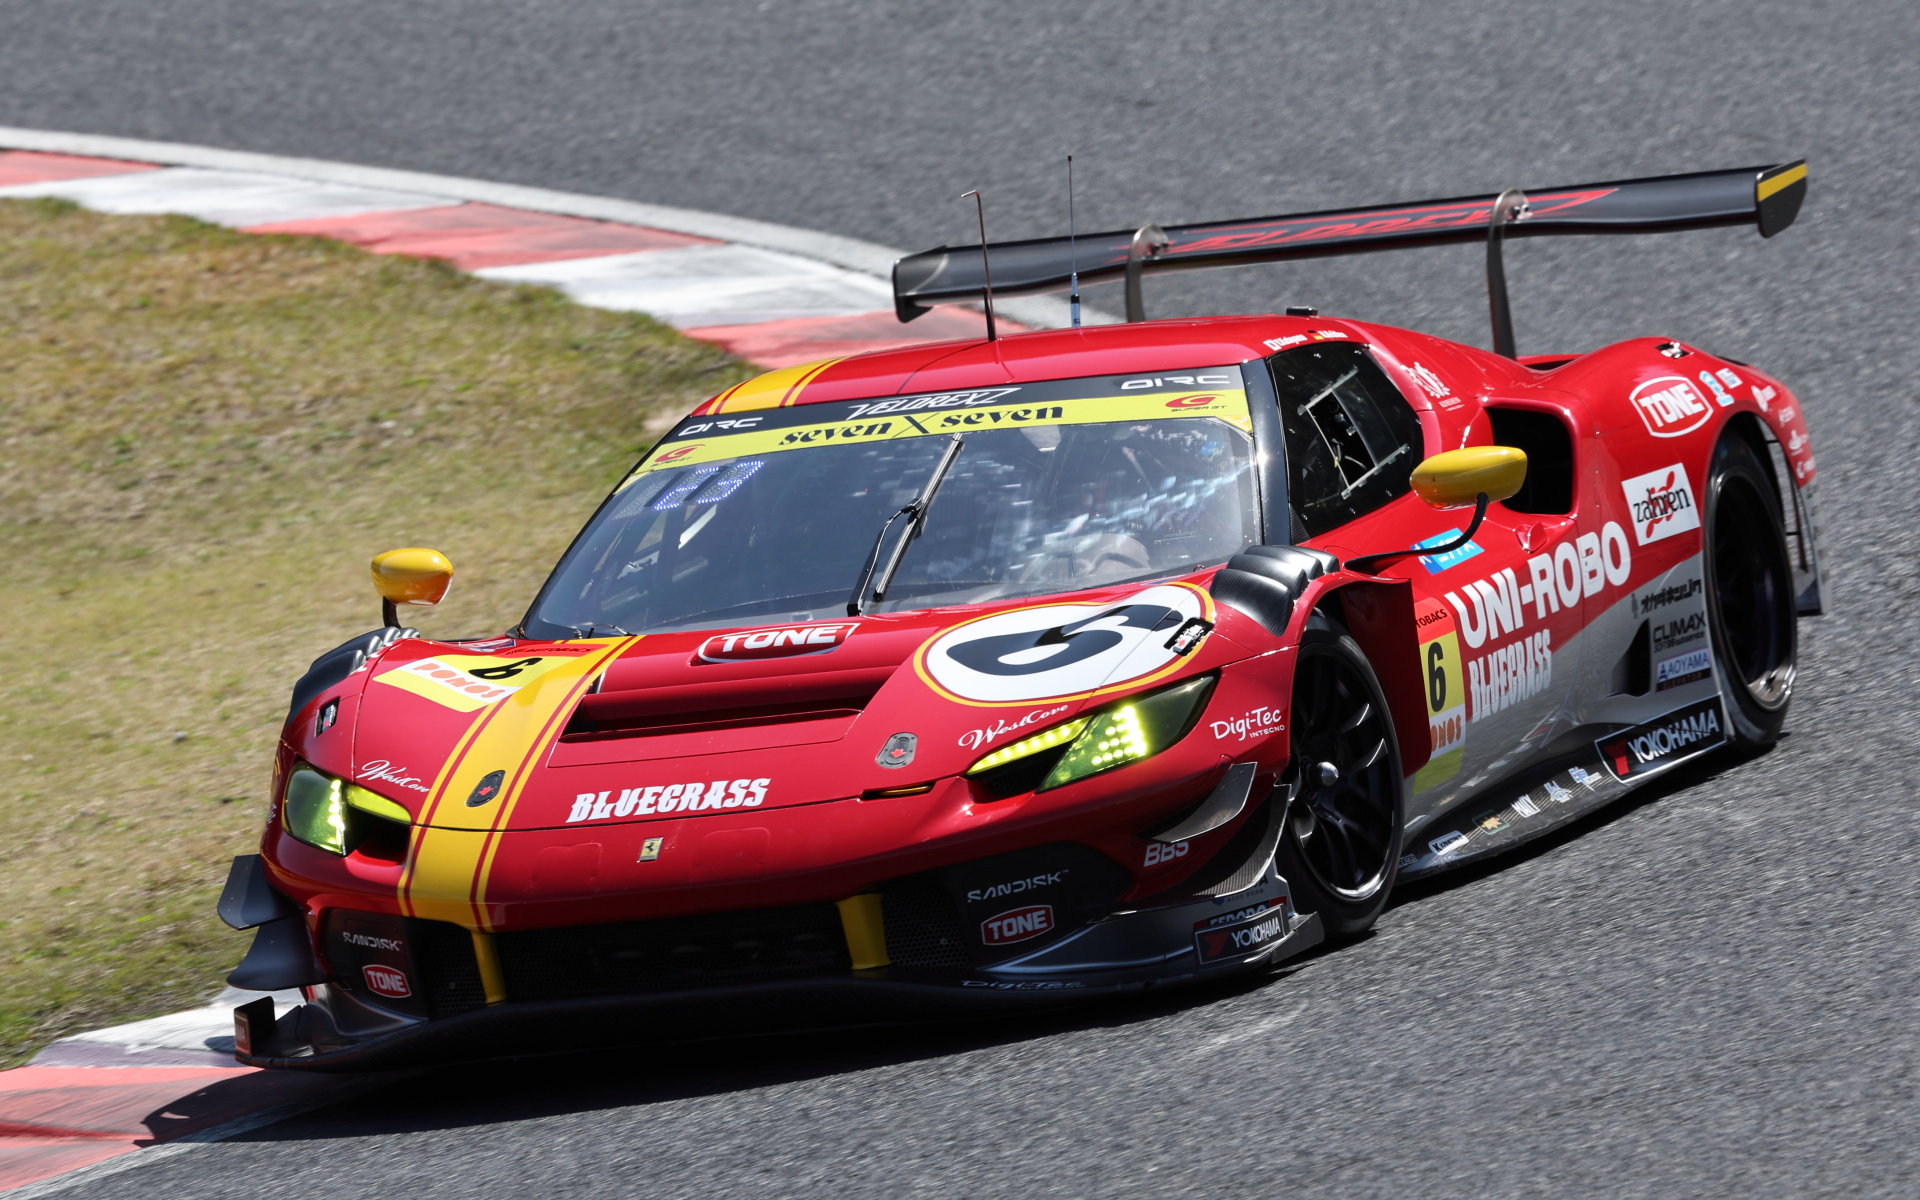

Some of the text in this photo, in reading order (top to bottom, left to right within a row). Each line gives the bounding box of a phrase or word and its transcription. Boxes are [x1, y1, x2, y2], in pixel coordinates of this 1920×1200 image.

[1638, 382, 1705, 428] TONE
[778, 422, 893, 446] seven
[940, 406, 1065, 428] seven
[1633, 486, 1691, 524] zahren
[1443, 521, 1632, 649] UNI-ROBO
[1415, 609, 1448, 628] TOBACS
[1653, 610, 1706, 643] CLIMAX
[721, 624, 845, 653] TONE
[945, 603, 1184, 677] 6
[412, 662, 506, 698] PONOS
[468, 657, 543, 680] 6
[1427, 642, 1447, 713] 6
[1468, 627, 1552, 724] BLUEGRASS
[1667, 651, 1709, 676] AOYAMA
[957, 704, 1069, 751] WestCove
[1209, 706, 1282, 741] Digi-Tec
[1249, 724, 1285, 739] INTECNO
[1429, 714, 1461, 752] ONOS
[1627, 708, 1720, 764] YOKOHAMA
[565, 778, 772, 823] BLUEGRASS
[1143, 841, 1189, 867] BBS
[988, 909, 1048, 940] TONE
[1231, 917, 1281, 948] YOKOHAMA
[367, 970, 407, 993] TONE
